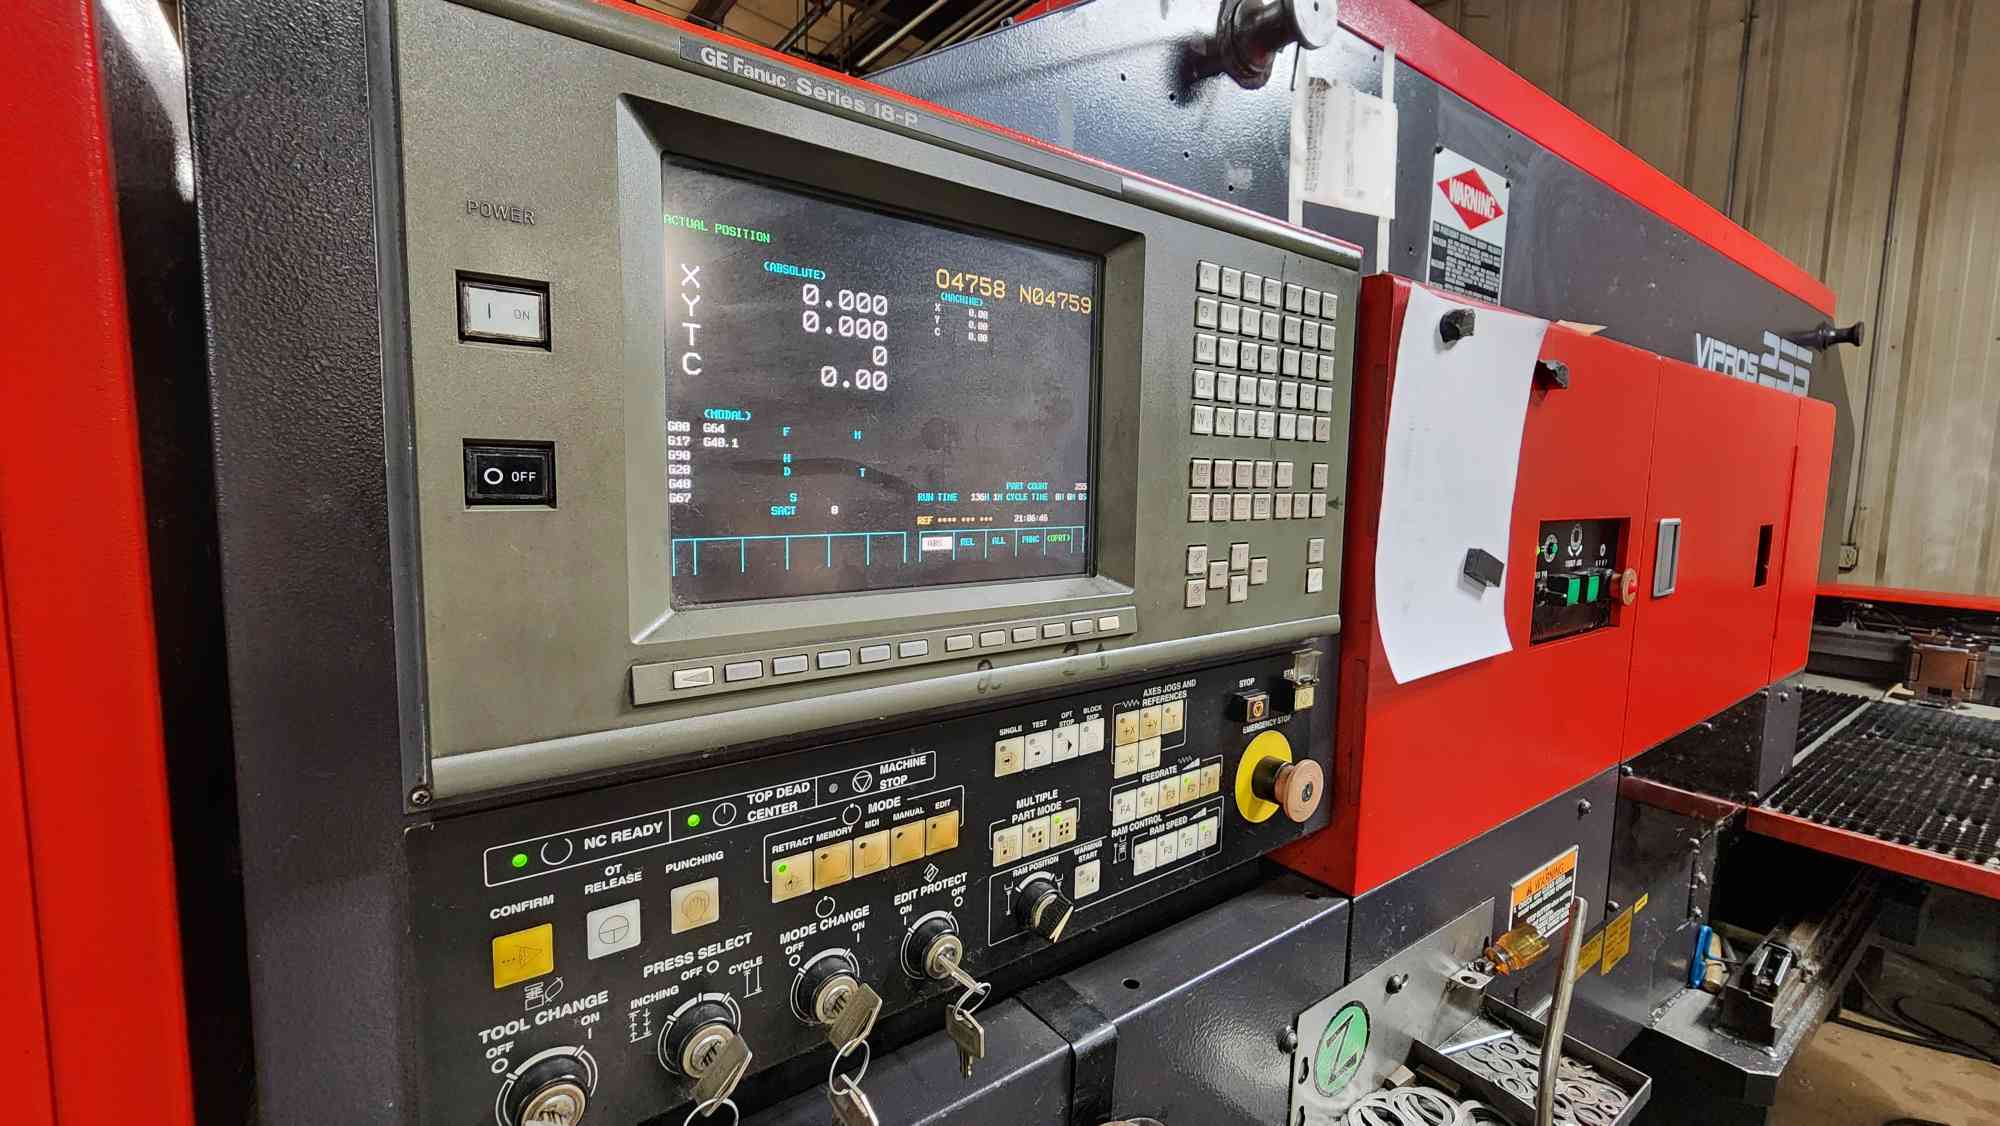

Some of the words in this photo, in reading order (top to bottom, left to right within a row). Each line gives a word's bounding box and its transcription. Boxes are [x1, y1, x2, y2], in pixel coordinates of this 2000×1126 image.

[699, 46, 729, 71] GE
[733, 56, 787, 89] Fanuc
[796, 77, 866, 114] Series
[872, 102, 919, 128] 18-P
[1449, 178, 1496, 220] WARNING
[466, 200, 537, 226] POWER
[663, 213, 708, 233] ACTUAL
[714, 223, 771, 244] POSITION
[681, 263, 701, 290] X
[802, 282, 889, 316] 0.000
[1019, 283, 1092, 315] N04759
[513, 308, 531, 323] ON
[681, 292, 701, 319] Y
[802, 309, 889, 341] 0.000
[682, 322, 702, 347] T
[872, 345, 889, 367] 0
[681, 351, 702, 377] C
[819, 364, 889, 393] 0.00
[703, 422, 725, 434] G64
[783, 427, 791, 437] F
[667, 435, 690, 447] G17
[511, 471, 537, 483] OFF
[669, 493, 691, 504] G67
[790, 492, 798, 503] S
[1143, 685, 1162, 697] AXES
[1163, 681, 1181, 693] JOGS
[1239, 677, 1255, 688] STOP
[1142, 690, 1188, 708] REFERENCES
[1061, 711, 1073, 720] OPT
[1083, 704, 1103, 715] BLOCK
[999, 724, 1023, 736] SINGLE
[1032, 719, 1048, 729] TEST
[1059, 719, 1075, 728] STOP
[879, 755, 927, 775] MACHINE
[1142, 764, 1178, 784] FEEDRATE
[879, 774, 909, 791] STOP
[747, 787, 774, 805] TOP
[776, 781, 811, 798] DEAD
[1016, 788, 1059, 810] MULTIPLE
[747, 799, 799, 822] CENTER
[868, 796, 902, 815] MODE
[893, 806, 925, 822] MANUAL
[935, 798, 952, 810] EDIT
[1011, 808, 1037, 824] PART
[1037, 800, 1062, 816] MODE
[816, 825, 854, 843] MEMORY
[864, 818, 880, 830] MDI
[1111, 825, 1129, 838] RAM
[1129, 813, 1163, 833] CONTROL
[1149, 823, 1165, 836] RAM
[1165, 815, 1188, 831] SPEED
[584, 833, 607, 851] NC
[611, 820, 664, 845] READY
[772, 835, 815, 855] RETRACT
[665, 850, 725, 875] PUNCHING
[1078, 850, 1098, 863] START
[604, 863, 622, 877] OT
[1012, 866, 1029, 879] RAM
[1029, 856, 1060, 875] POSITION
[584, 871, 643, 896] RELEASE
[894, 889, 919, 907] EDIT
[920, 872, 968, 898] PROTECT
[951, 885, 967, 897] OFF
[489, 894, 555, 920] CONFIRM
[900, 903, 913, 915] ON
[779, 923, 817, 945] MODE
[819, 905, 870, 933] CHANGE
[851, 920, 866, 934] ON
[643, 951, 695, 978] PRESS
[697, 932, 753, 962] SELECT
[784, 941, 805, 956] OFF
[680, 965, 705, 982] OFF
[728, 956, 764, 976] CYCLE
[630, 984, 680, 1010] INCHING
[478, 1016, 531, 1045] TOOL
[535, 990, 609, 1025] CHANGE
[580, 1011, 600, 1027] ON
[485, 1041, 515, 1060] OFF
